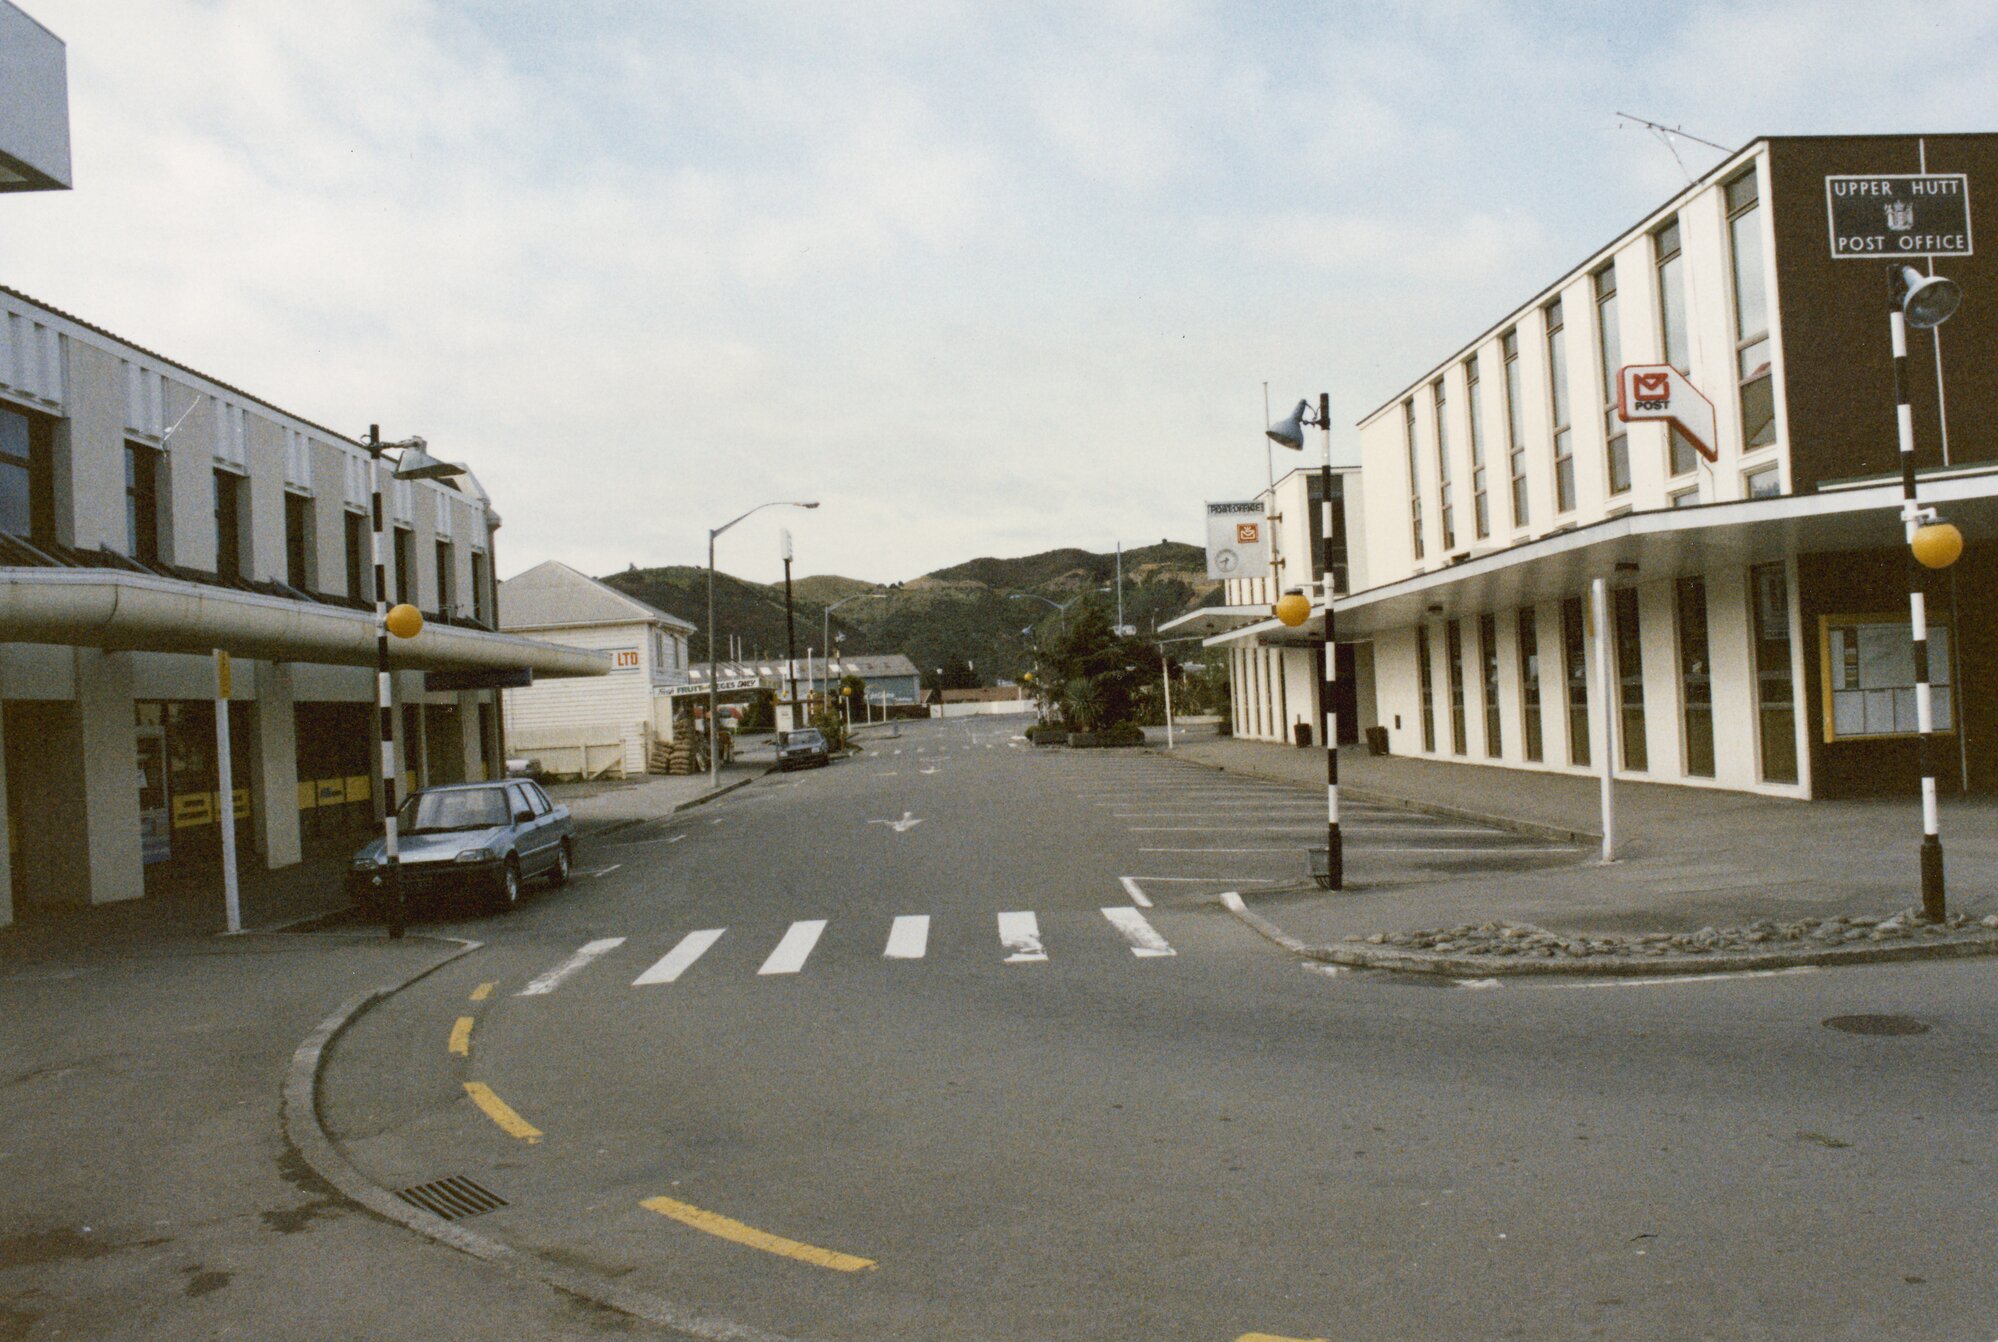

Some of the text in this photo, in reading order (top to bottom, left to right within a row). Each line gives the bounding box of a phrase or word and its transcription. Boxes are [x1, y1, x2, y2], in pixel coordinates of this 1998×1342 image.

[1834, 180, 1959, 196] UPPER HUTT
[1838, 235, 1964, 251] POST OFFICE
[1634, 400, 1670, 411] POST
[617, 652, 639, 666] LTD
[676, 684, 702, 694] FRUIT
